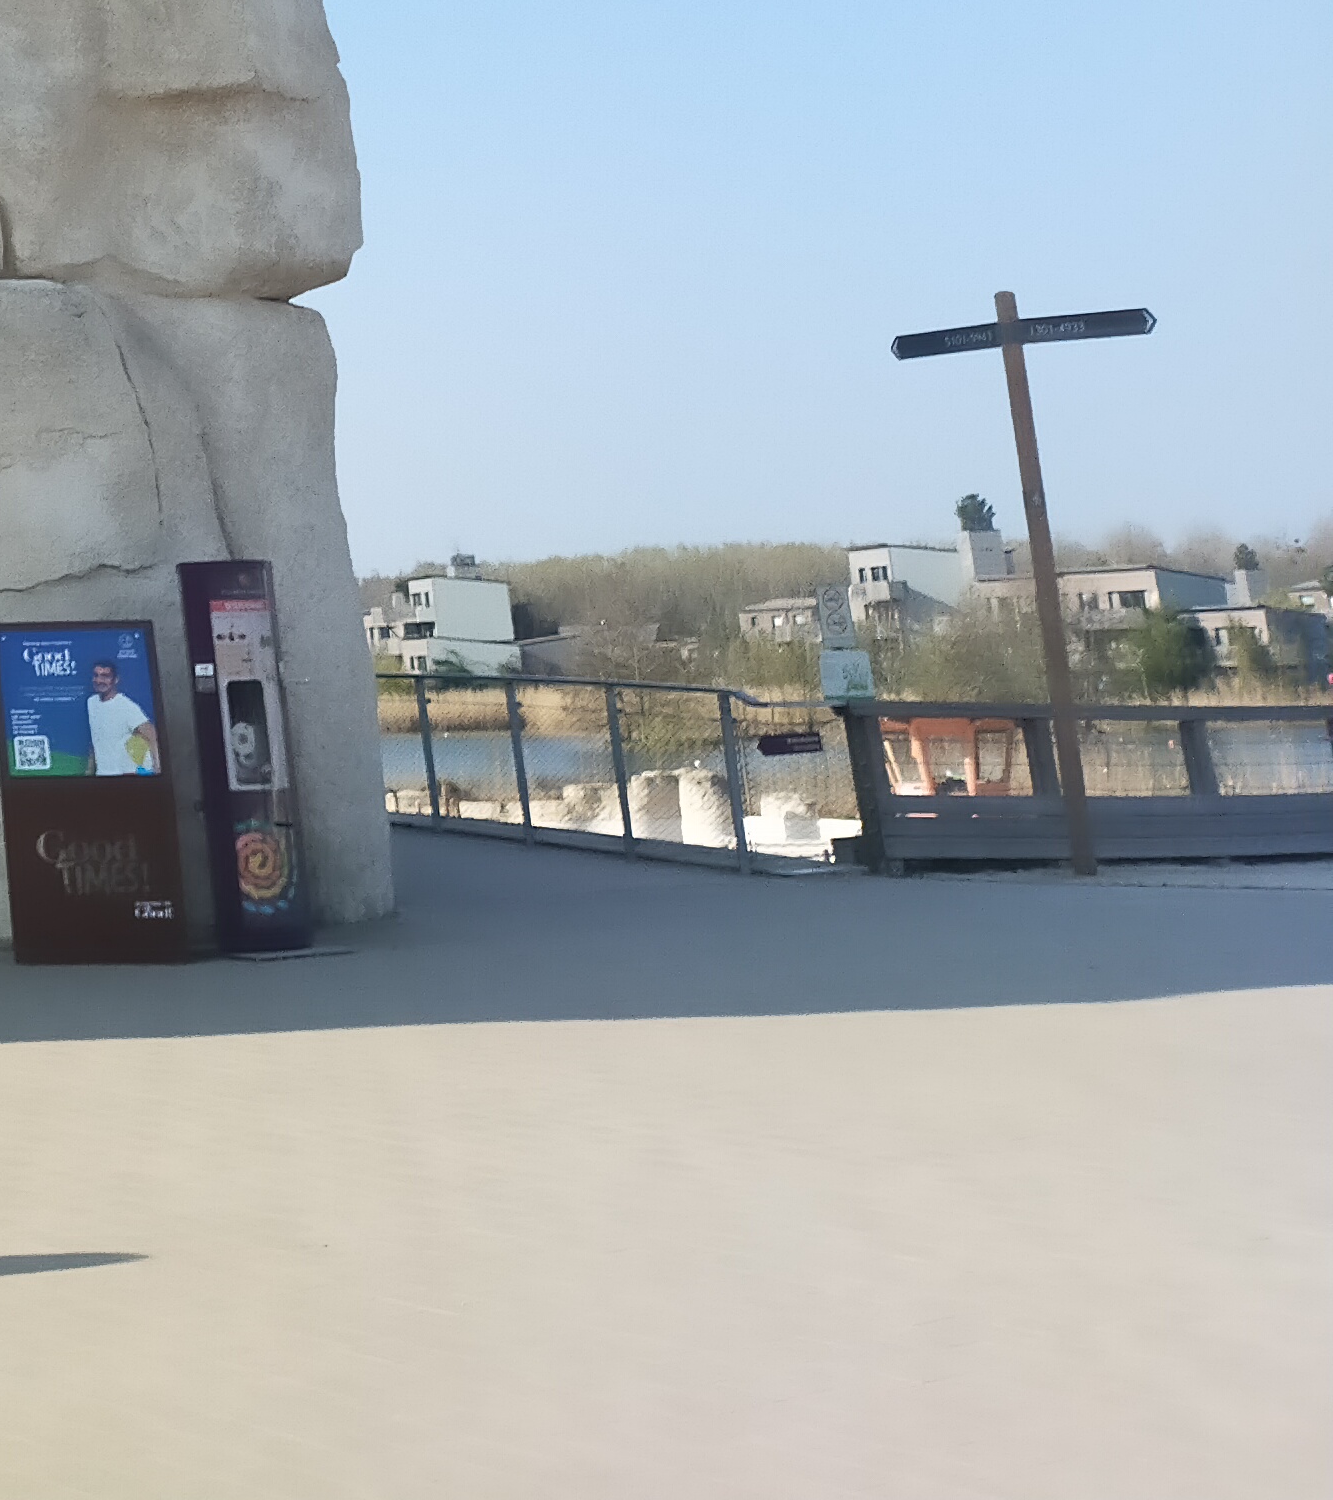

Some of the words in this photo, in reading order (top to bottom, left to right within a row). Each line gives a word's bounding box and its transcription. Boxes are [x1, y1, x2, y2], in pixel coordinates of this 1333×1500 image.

[23, 646, 70, 663] Good
[32, 660, 78, 677] TIMES!
[35, 829, 138, 866] Good
[55, 859, 152, 896] TIMES!
